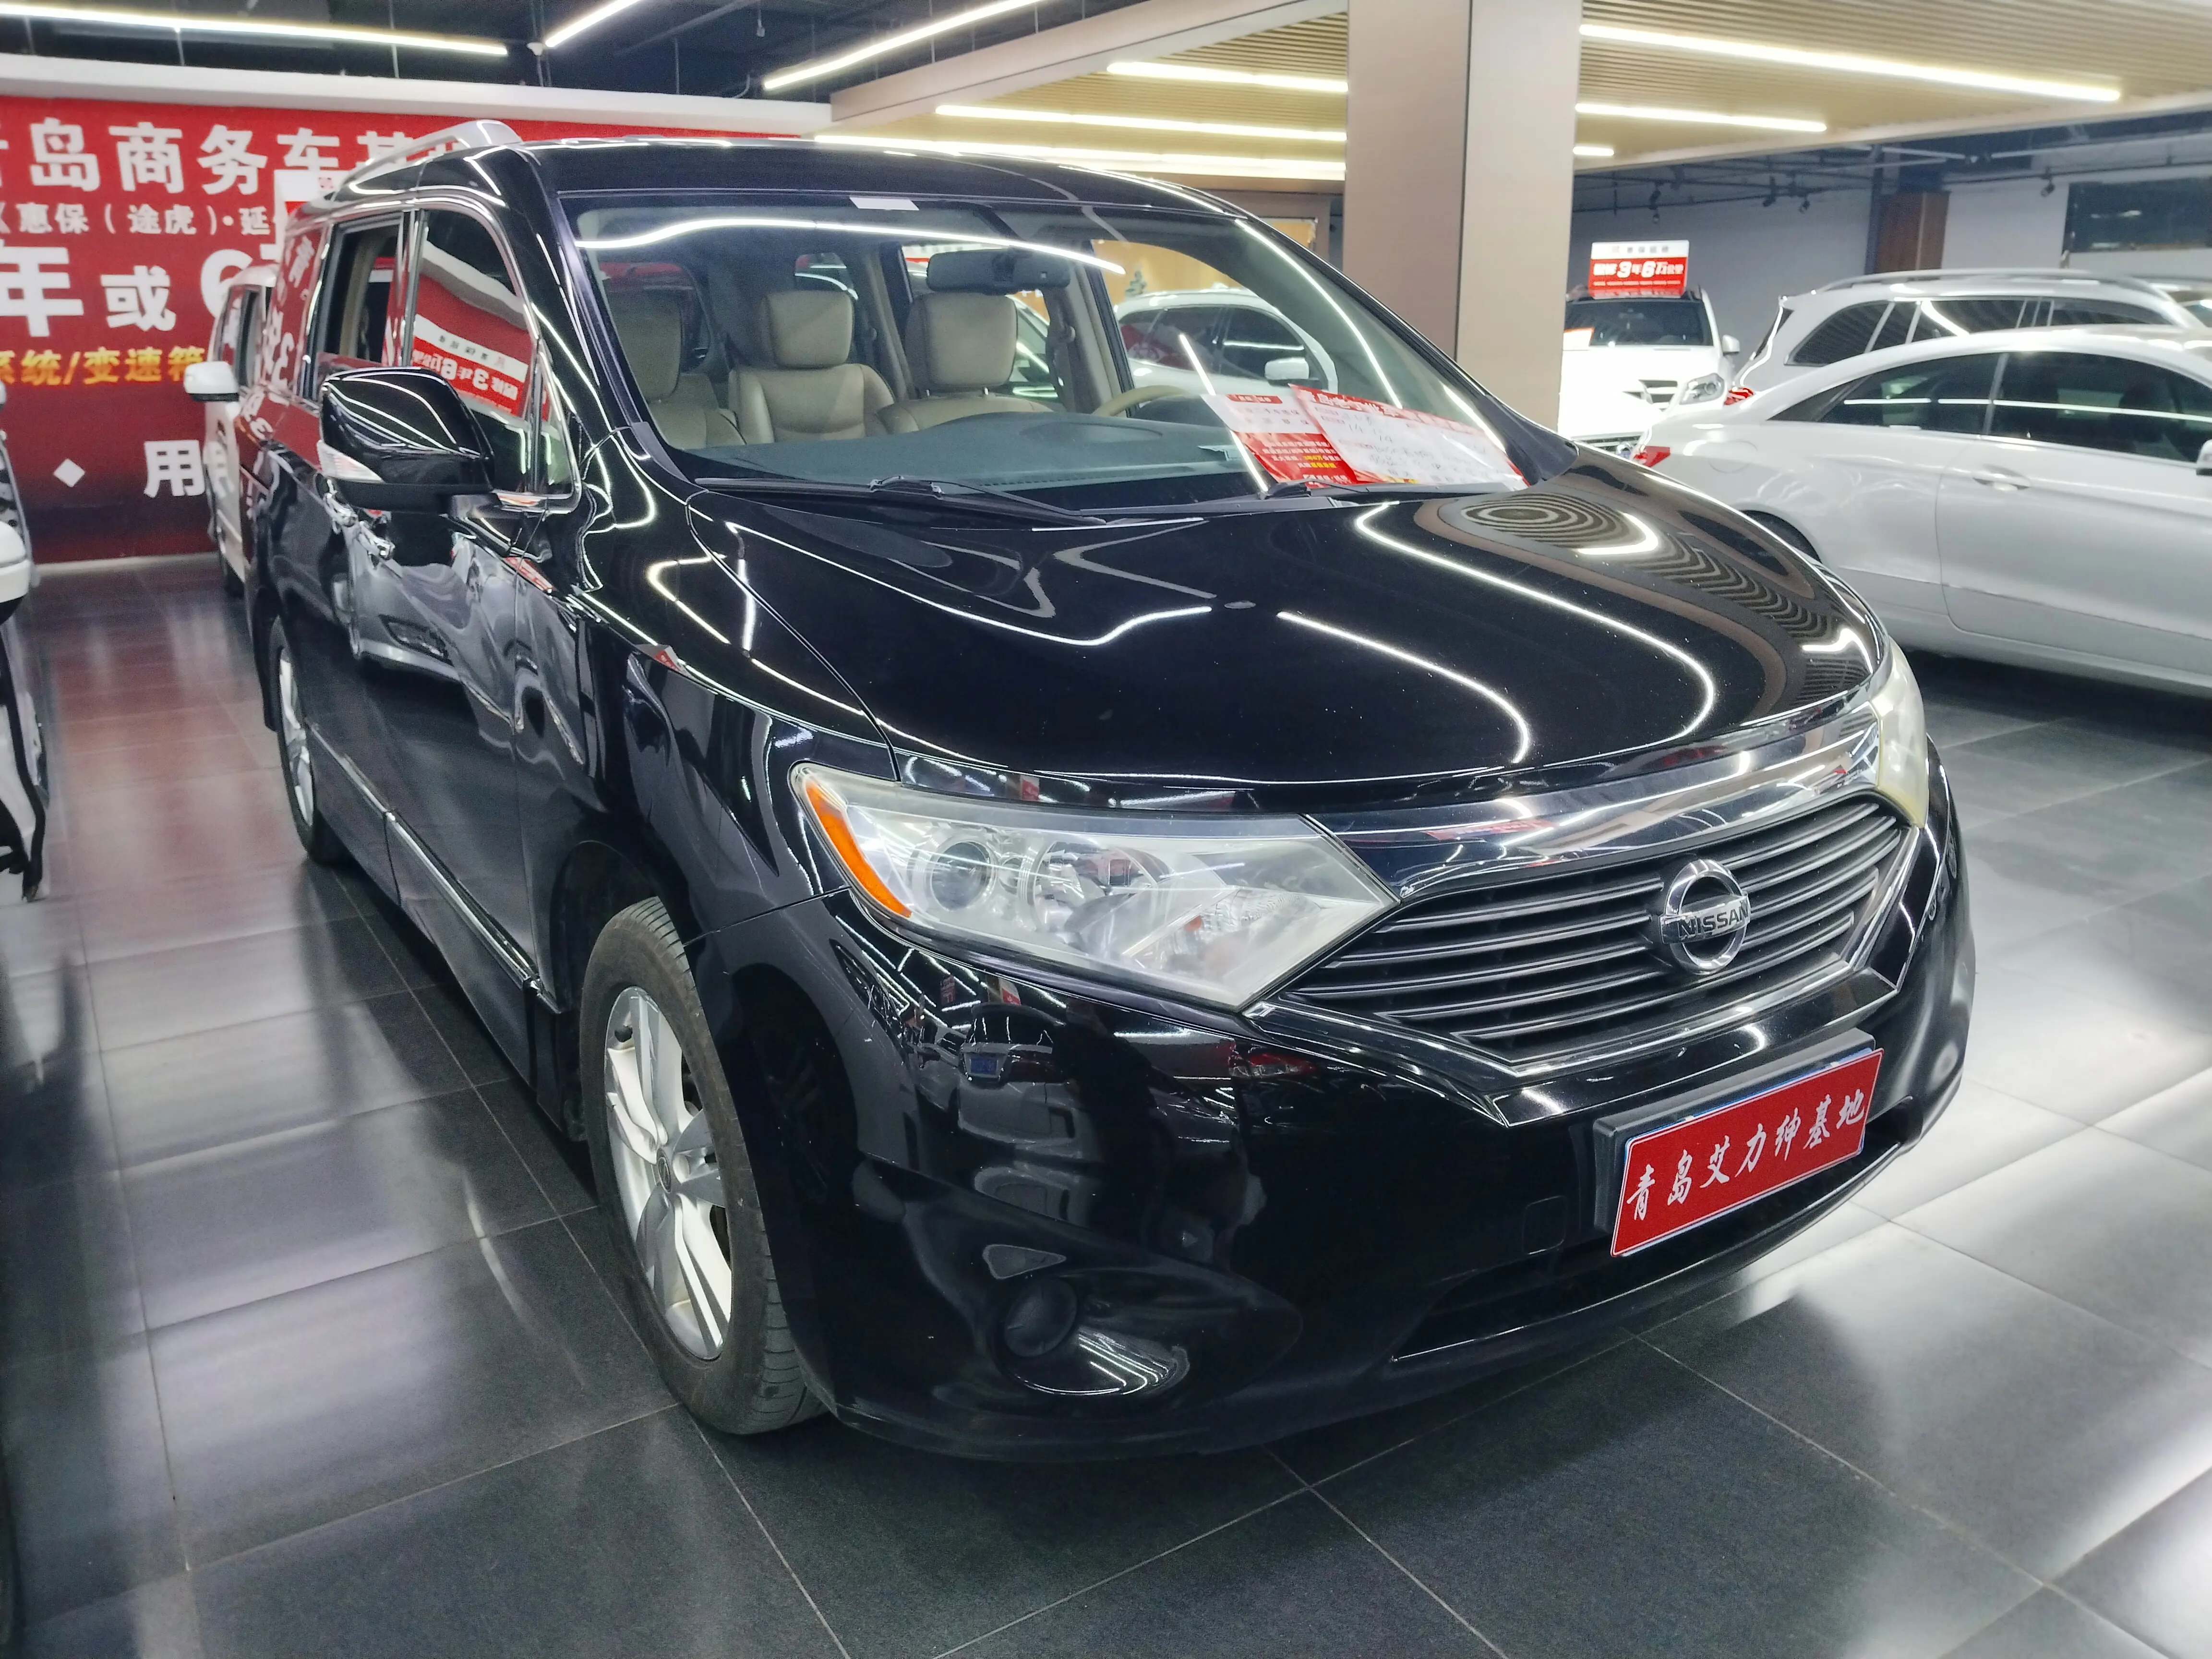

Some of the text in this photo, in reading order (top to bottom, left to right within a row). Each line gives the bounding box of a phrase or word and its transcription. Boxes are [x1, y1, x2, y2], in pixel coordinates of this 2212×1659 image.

[144, 440, 205, 498] 用
[1678, 900, 1749, 937] NISSAN
[1626, 1088, 1865, 1221] 青岛艾力绅基地
